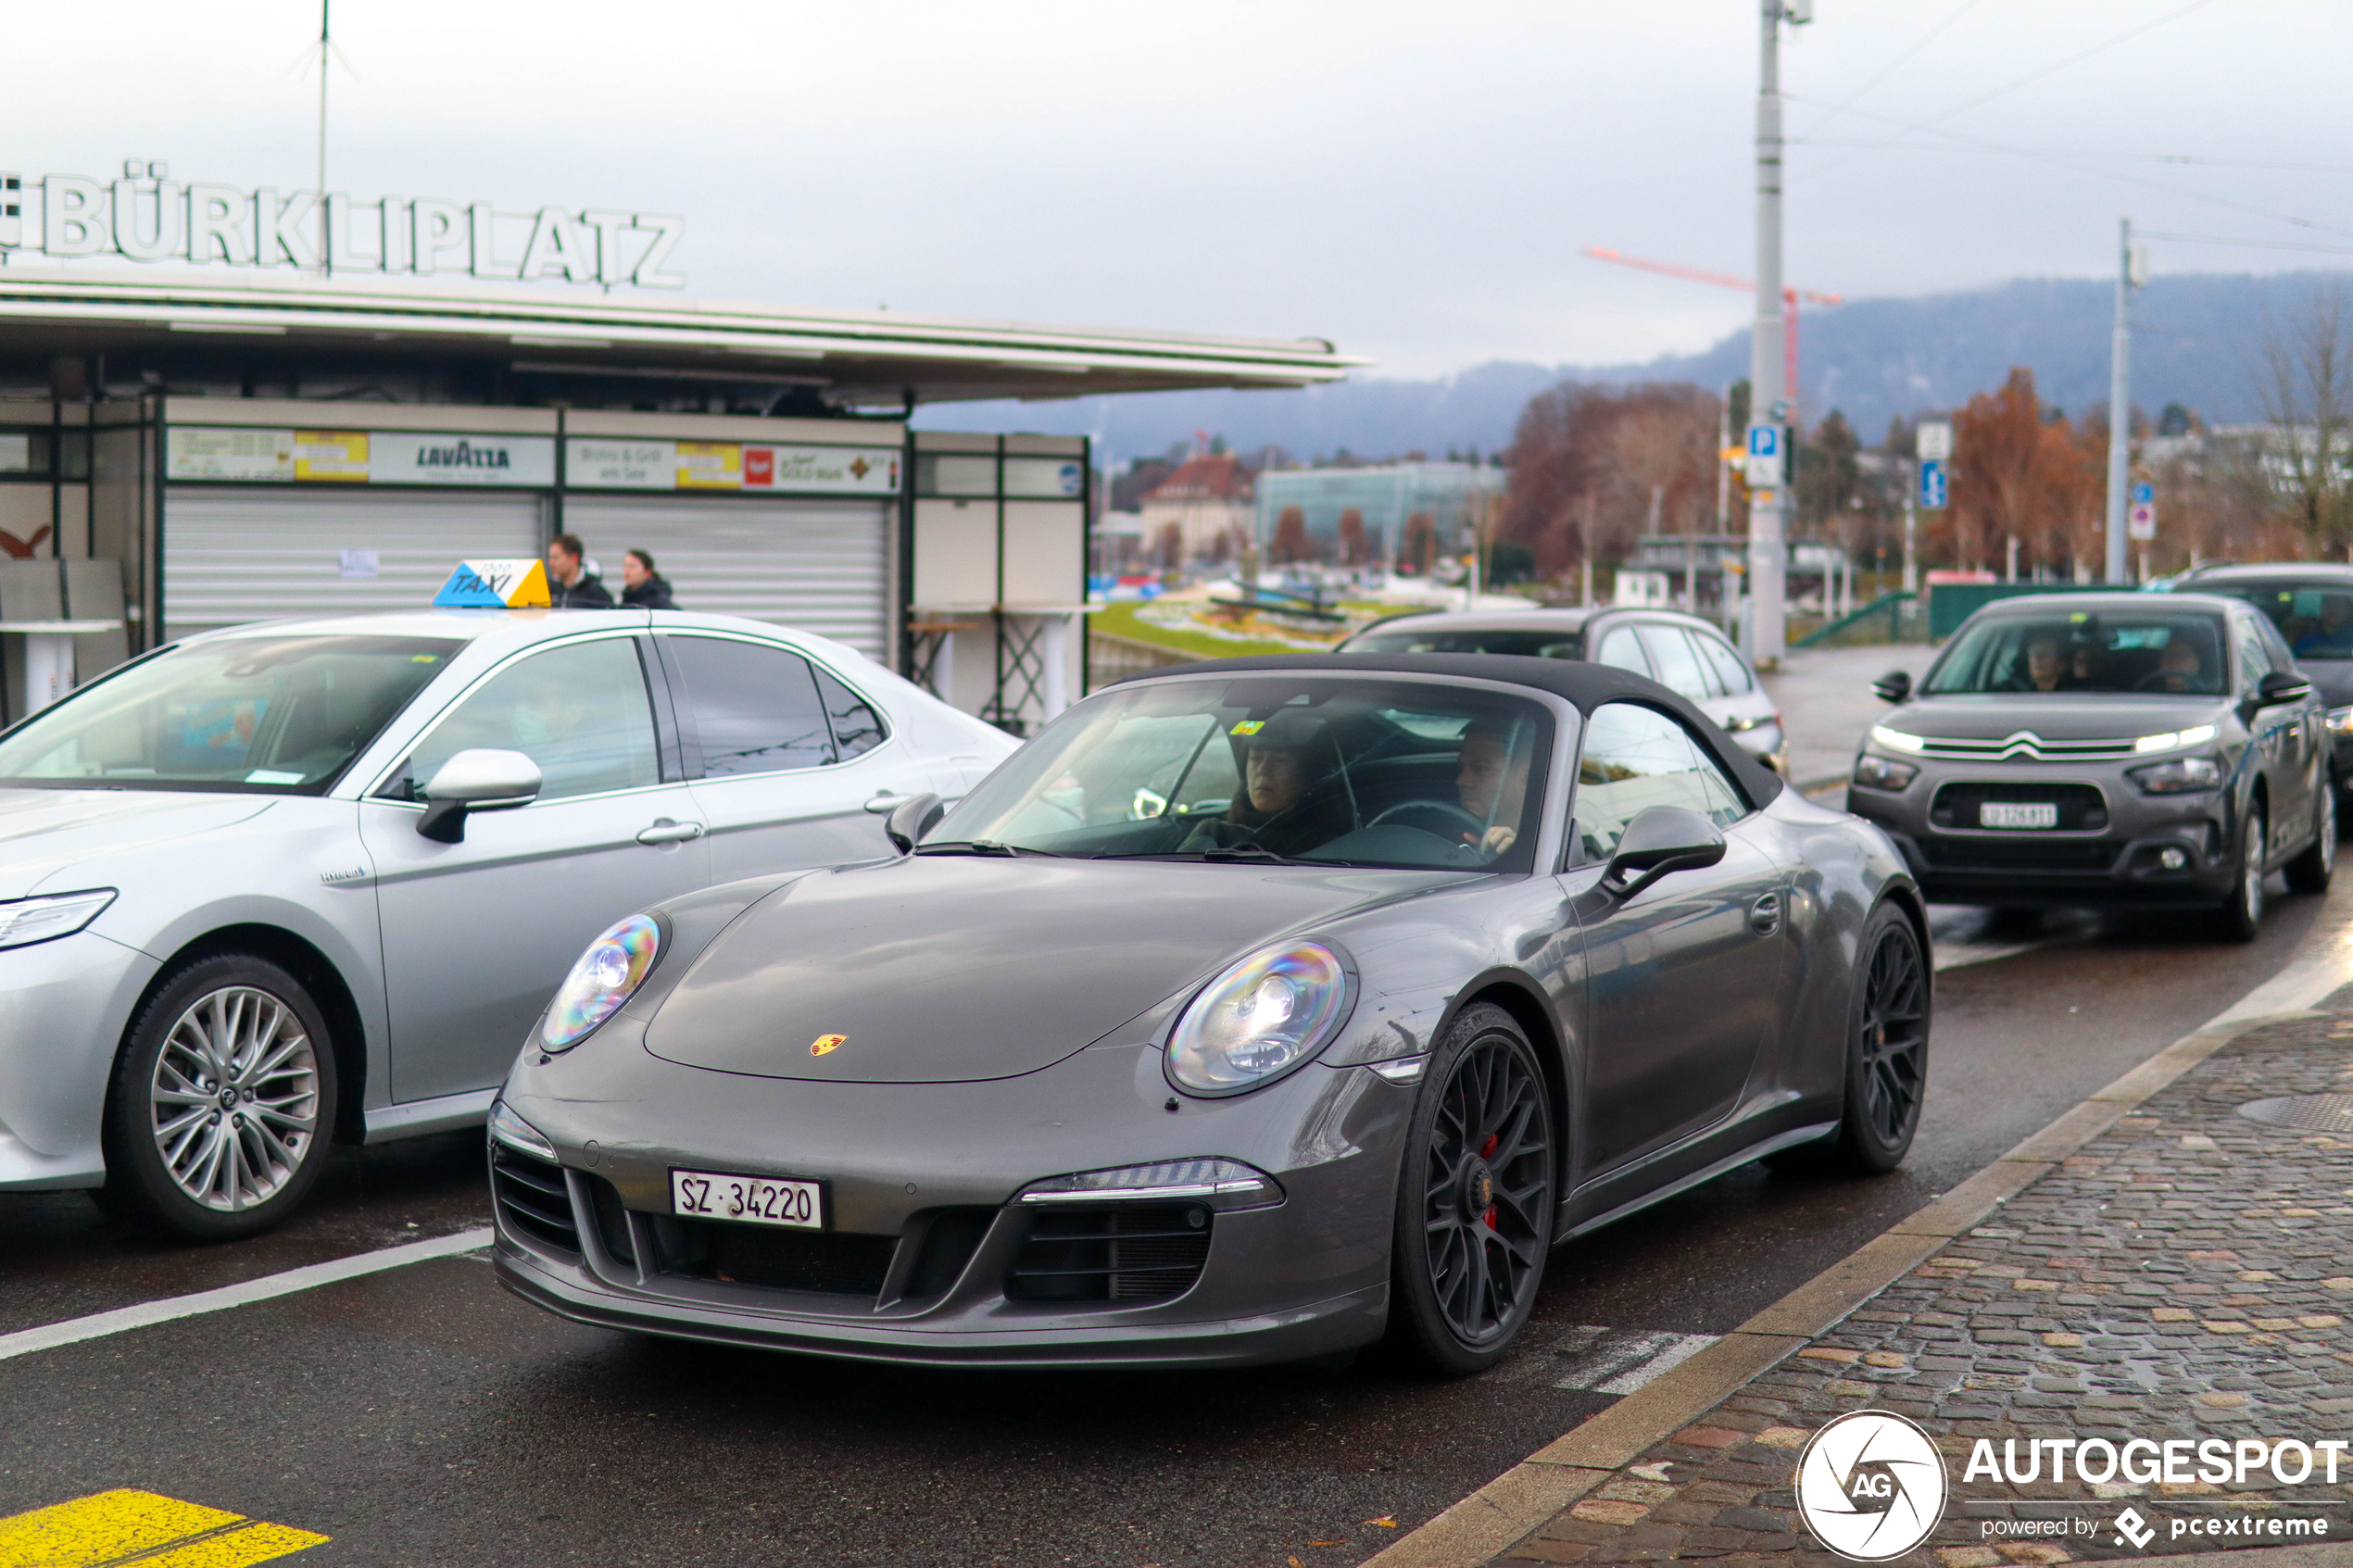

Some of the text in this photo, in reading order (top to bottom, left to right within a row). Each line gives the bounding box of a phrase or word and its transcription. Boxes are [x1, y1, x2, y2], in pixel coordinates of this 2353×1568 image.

[43, 158, 688, 288] BÜRKLIPLATZ
[1756, 431, 1772, 454] P
[452, 573, 512, 594] TAXI
[681, 1178, 812, 1221] SZ 34220
